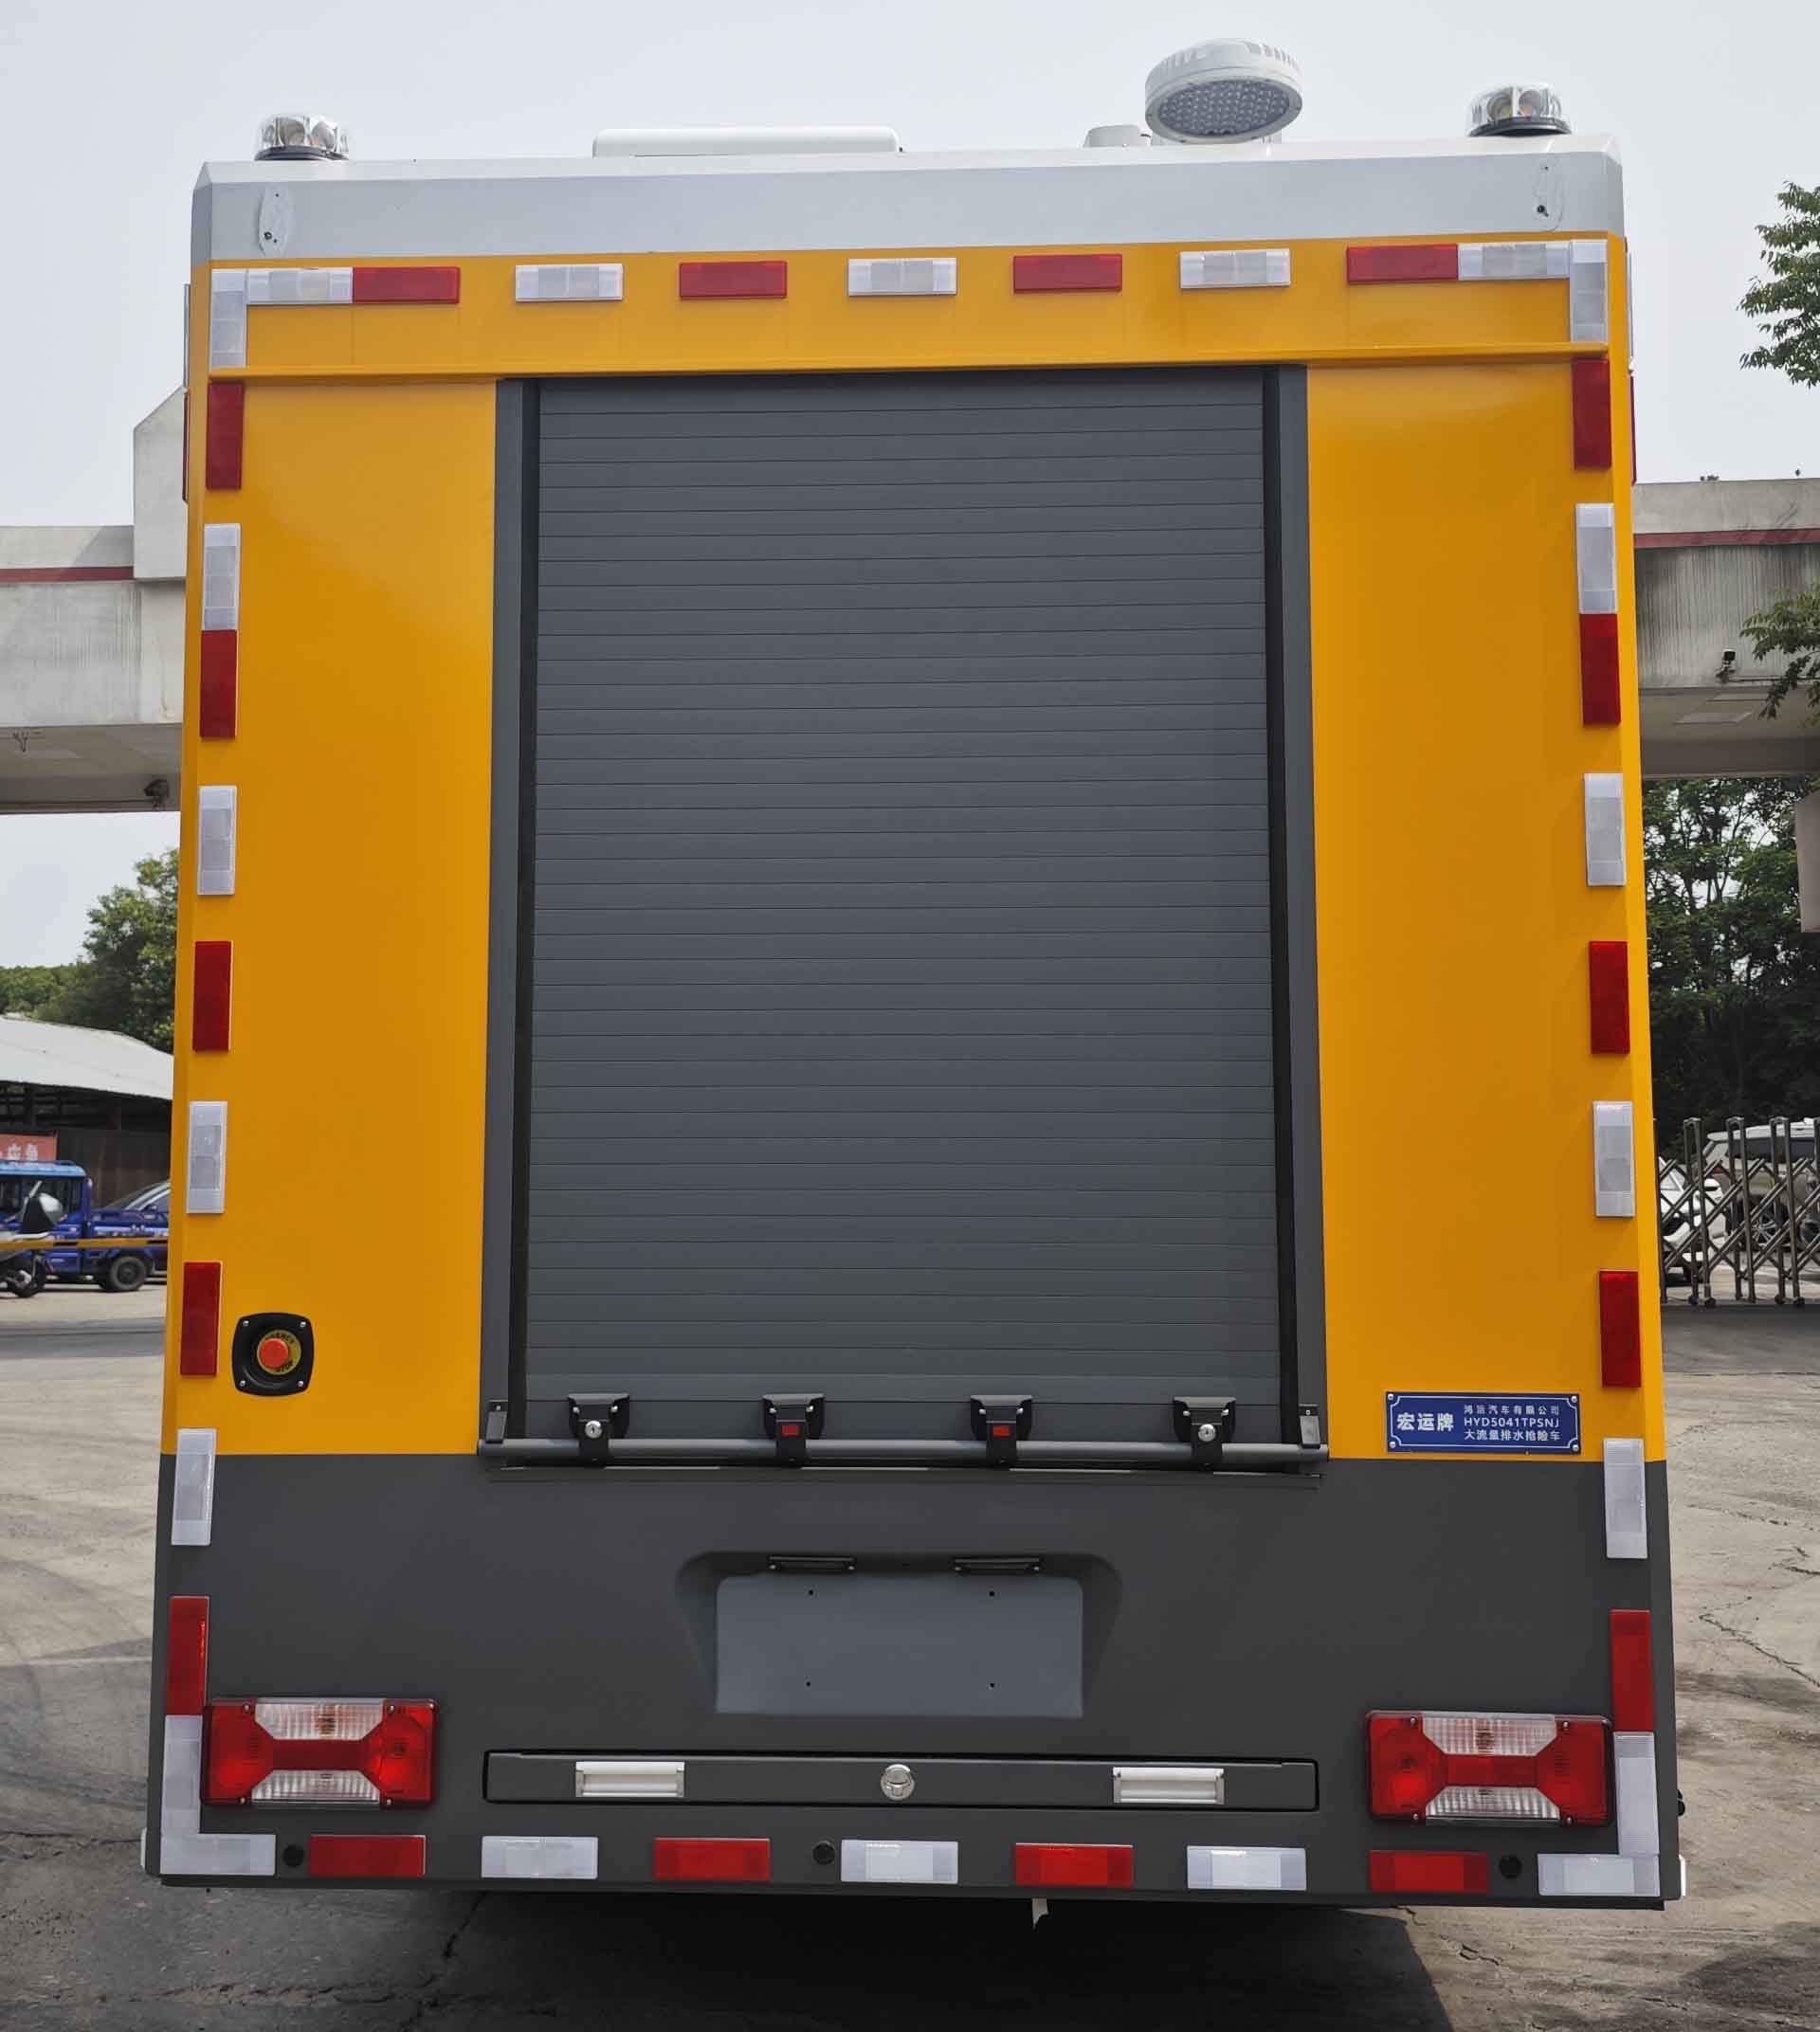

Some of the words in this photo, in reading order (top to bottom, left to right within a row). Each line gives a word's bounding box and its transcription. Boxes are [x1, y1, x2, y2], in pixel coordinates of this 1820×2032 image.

[1397, 1412, 1454, 1432] 宏运牌
[1464, 1417, 1560, 1427] HYD5041TPSNJ
